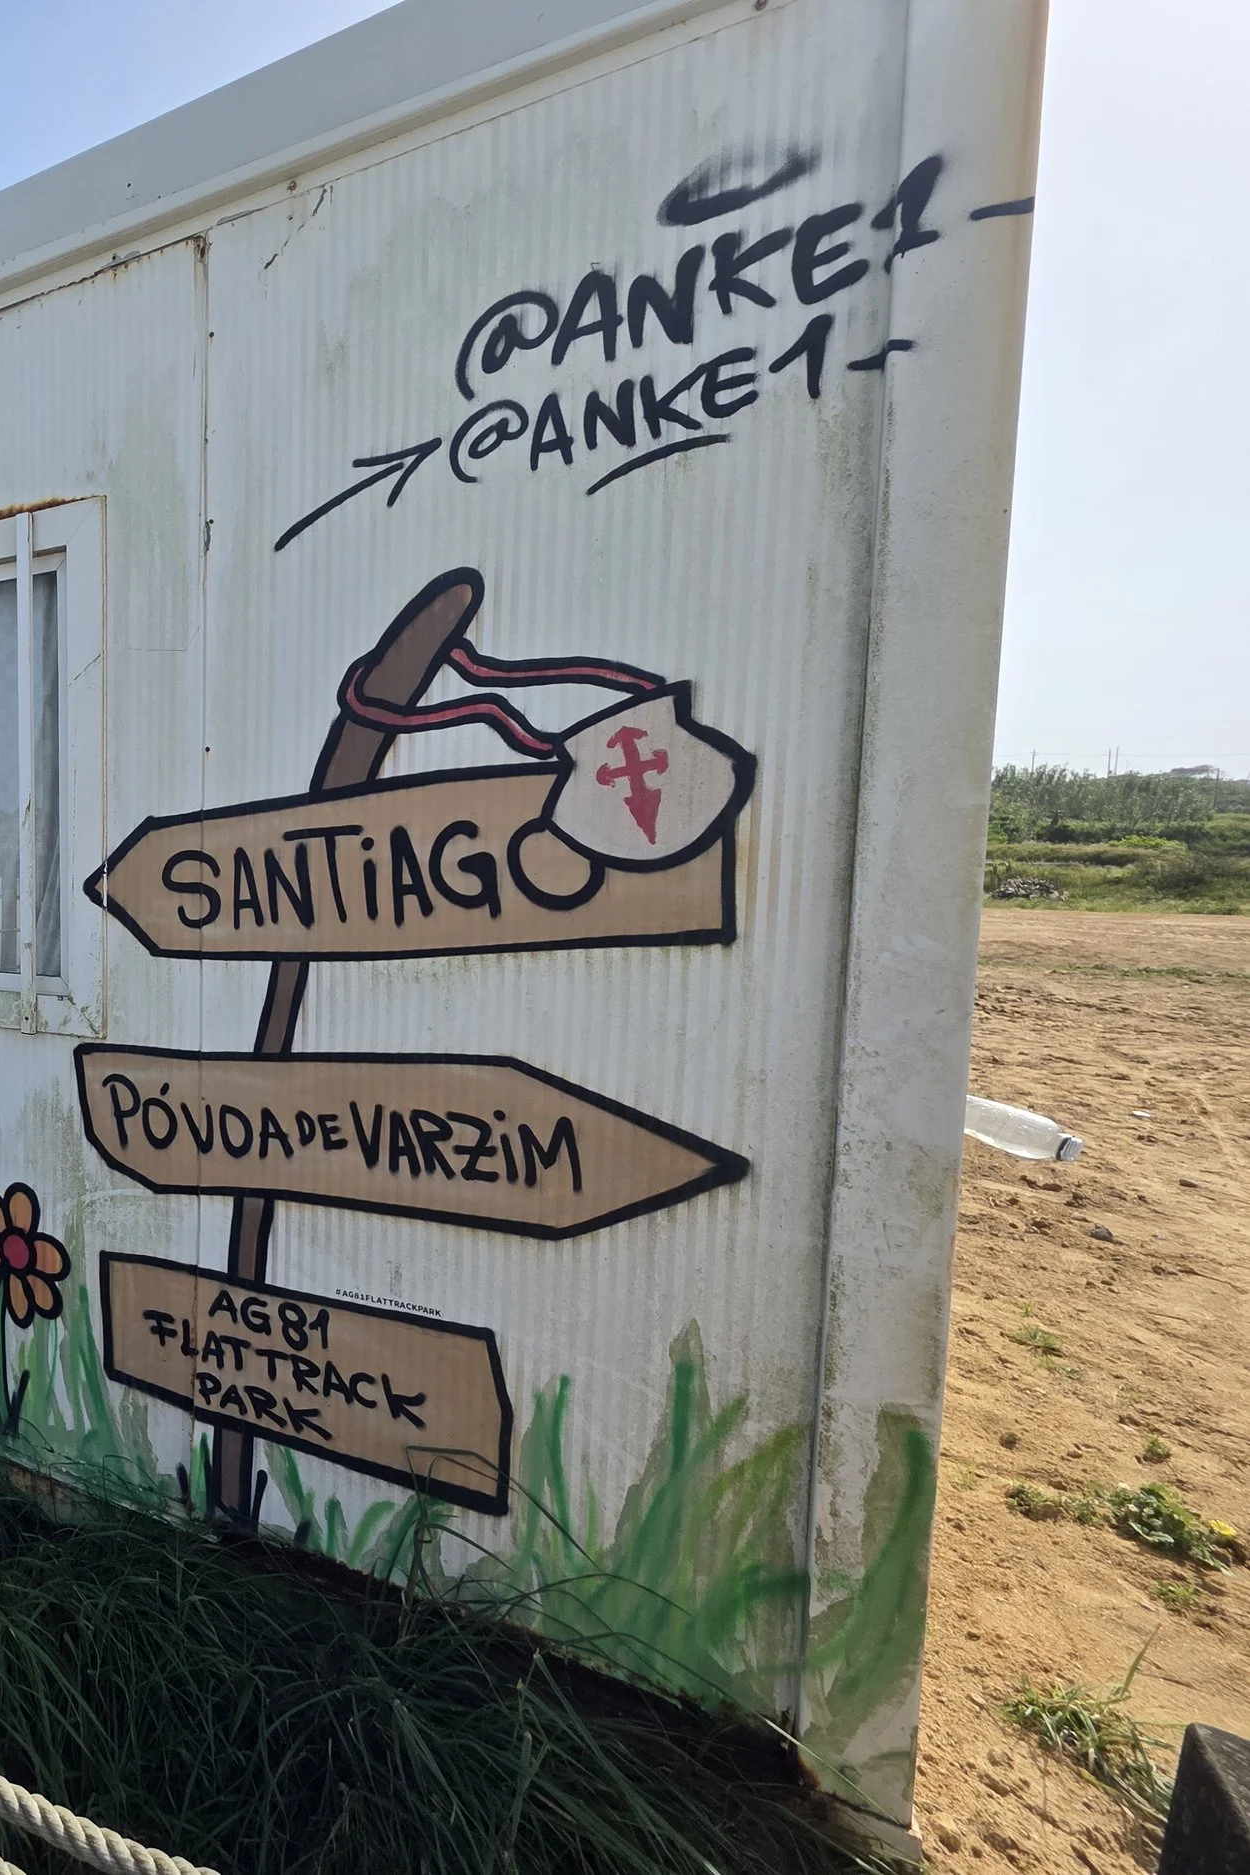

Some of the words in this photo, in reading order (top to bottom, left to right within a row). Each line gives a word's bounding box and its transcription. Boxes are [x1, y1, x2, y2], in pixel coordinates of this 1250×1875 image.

[102, 1074, 294, 1160] PÓVOA
[297, 1111, 348, 1150] DE
[335, 1288, 442, 1318] #AG81FLATTRACKPARK
[143, 1309, 251, 1370] FLAT
[254, 1347, 427, 1429] TRACK
[195, 1371, 334, 1441] PARK
